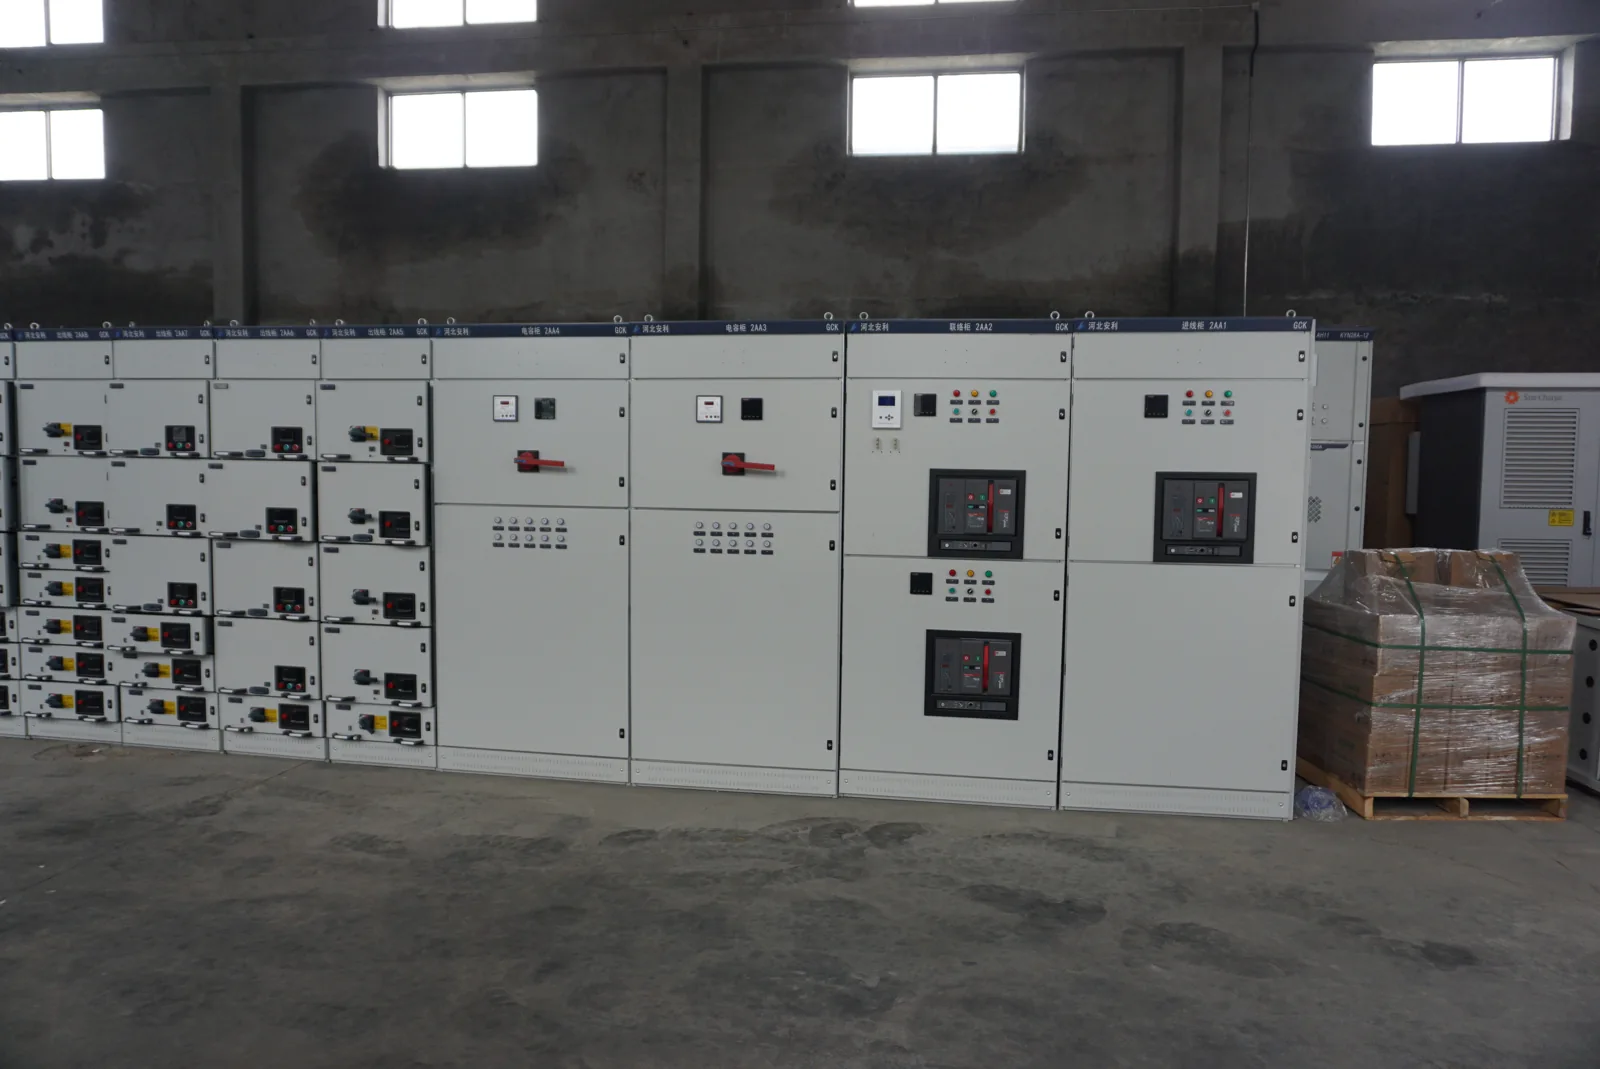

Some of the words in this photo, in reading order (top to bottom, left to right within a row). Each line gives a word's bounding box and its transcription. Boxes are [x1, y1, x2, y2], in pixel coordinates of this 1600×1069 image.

[614, 326, 627, 334] GCK
[642, 324, 669, 333] 河北安利
[725, 323, 747, 332] 电容柜
[750, 323, 767, 332] 2AA3
[825, 323, 839, 331] GCK
[860, 322, 889, 332] 河北安利
[949, 322, 971, 331] 联络柜
[975, 322, 993, 331] 2AA2
[1055, 322, 1069, 331] GCK
[1088, 321, 1118, 330] 河北安利
[1181, 321, 1204, 330] 进线柜
[1209, 321, 1228, 330] 2AA1
[1293, 321, 1308, 330] GCK
[389, 327, 404, 336] 2AA5
[416, 327, 428, 335] GCK
[443, 327, 469, 336] 河北安利
[521, 327, 541, 336] 电容柜
[544, 327, 560, 335] 2AA4
